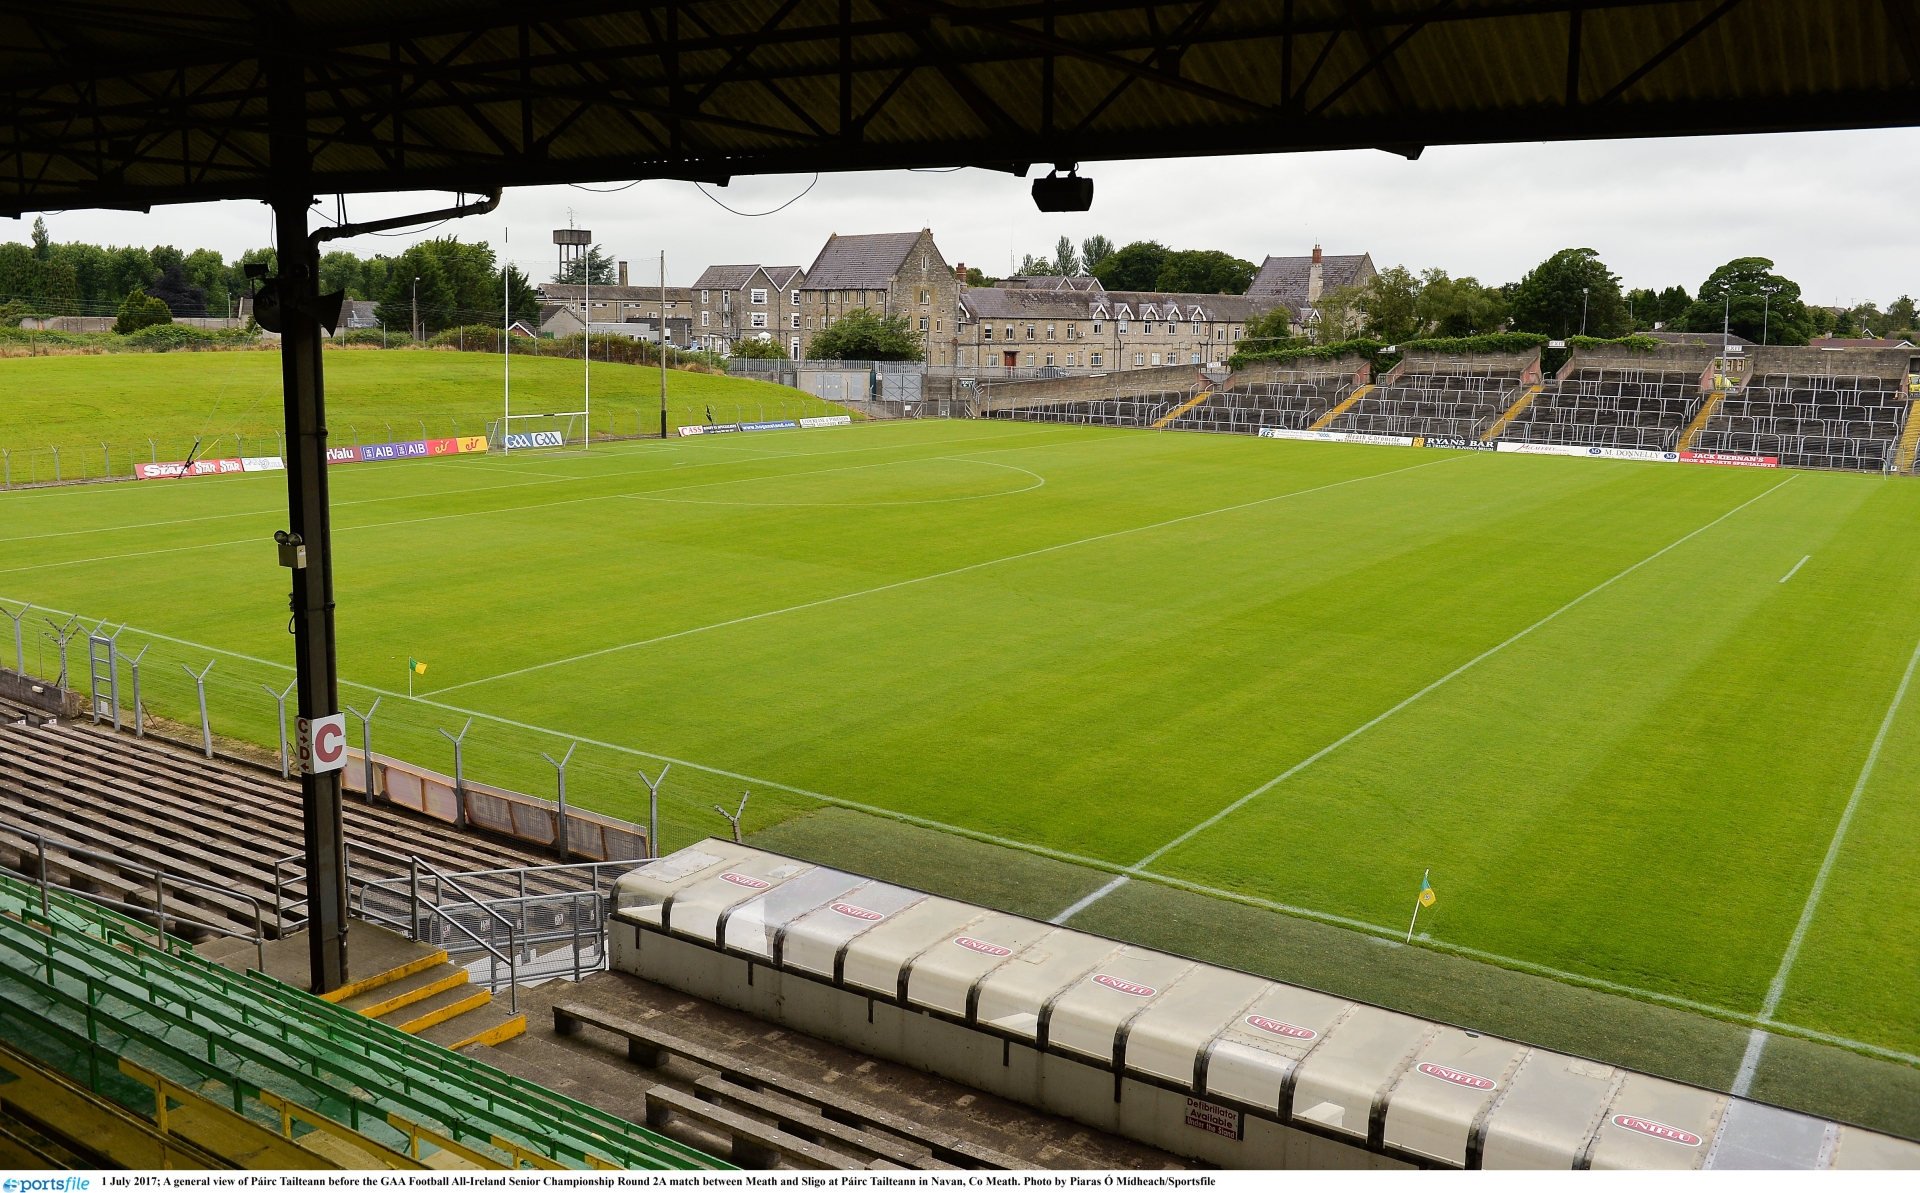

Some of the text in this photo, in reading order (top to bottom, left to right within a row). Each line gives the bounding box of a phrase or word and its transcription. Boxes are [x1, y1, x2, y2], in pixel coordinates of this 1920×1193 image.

[681, 426, 703, 436] CASS
[742, 422, 796, 430] www.hoganstand.com
[408, 443, 426, 455] AIB
[434, 440, 450, 454] eir
[465, 438, 479, 451] eir
[1426, 437, 1466, 446] RYANS
[1469, 440, 1495, 448] BAR
[326, 447, 354, 460] rValu
[375, 446, 394, 458] AIB
[1616, 450, 1661, 459] DONNELLY
[1717, 454, 1764, 463] KIERNAN'S
[195, 461, 217, 474] STAR
[220, 460, 241, 473] STAR
[1733, 460, 1776, 468] SPECIALISTS
[297, 719, 308, 734] C
[315, 723, 343, 763] C
[299, 745, 311, 761] D
[726, 874, 764, 888] UNIFLU
[837, 905, 878, 920] UNIFLU
[960, 938, 1006, 956] UNIFLU
[1099, 976, 1150, 996] UNIFLU
[1253, 1017, 1310, 1039] UNIFLU
[1426, 1065, 1489, 1088] UNIFLU
[1187, 1097, 1237, 1121] Defibrillator
[1190, 1108, 1233, 1129] Available
[1187, 1116, 1236, 1139] Under the Stand
[1622, 1118, 1691, 1142] UNIFLU
